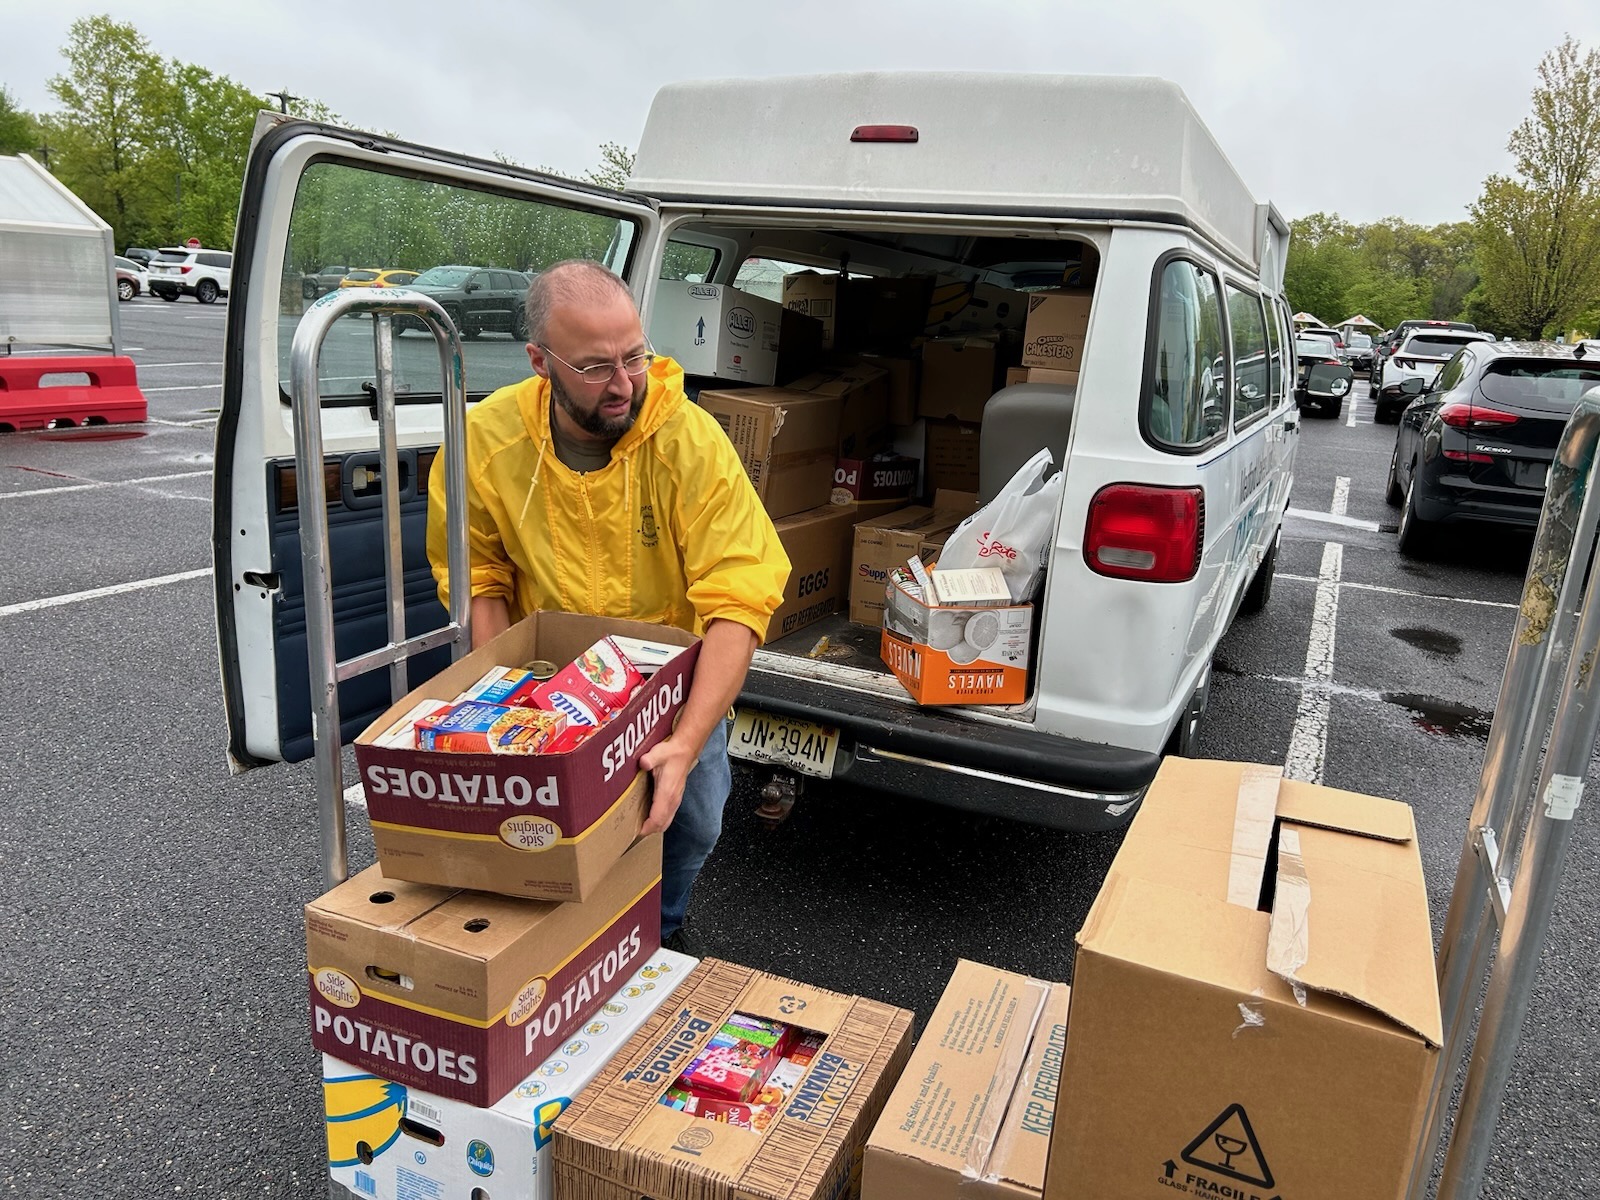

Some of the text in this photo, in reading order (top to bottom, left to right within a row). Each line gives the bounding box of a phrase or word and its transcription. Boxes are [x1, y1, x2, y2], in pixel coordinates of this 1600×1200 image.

[691, 284, 717, 297] ALLEN
[729, 311, 755, 333] ALLEN
[694, 338, 706, 346] UP
[1026, 342, 1073, 359] CAKESTERS
[1037, 336, 1064, 345] OREO
[1475, 444, 1512, 454] TUCSON
[798, 567, 830, 598] EGGS
[781, 614, 798, 633] KEEP
[888, 642, 921, 680] NAVELS
[948, 674, 1004, 689] NAVELS
[588, 690, 606, 708] RICE
[601, 672, 684, 782] POTATOES
[768, 713, 811, 731] New Jersey
[367, 764, 559, 806] POTATOES
[506, 821, 553, 836] Delights
[520, 834, 544, 847] Side
[327, 973, 345, 988] Side
[525, 925, 641, 1056] POTATOES
[319, 982, 354, 1004] Delights
[518, 986, 534, 1006] Side
[511, 995, 541, 1023] Delights
[315, 1006, 477, 1085] POTATOES
[632, 1015, 690, 1077] SUPERIOR QUALITY
[640, 1018, 712, 1083] Belinda
[785, 1052, 843, 1121] BANANAS
[900, 1062, 942, 1131] Egg Safety and Quality
[1021, 1101, 1053, 1136] KEEP
[468, 1156, 493, 1171] Chiquita
[1157, 1177, 1188, 1192] GLASS
